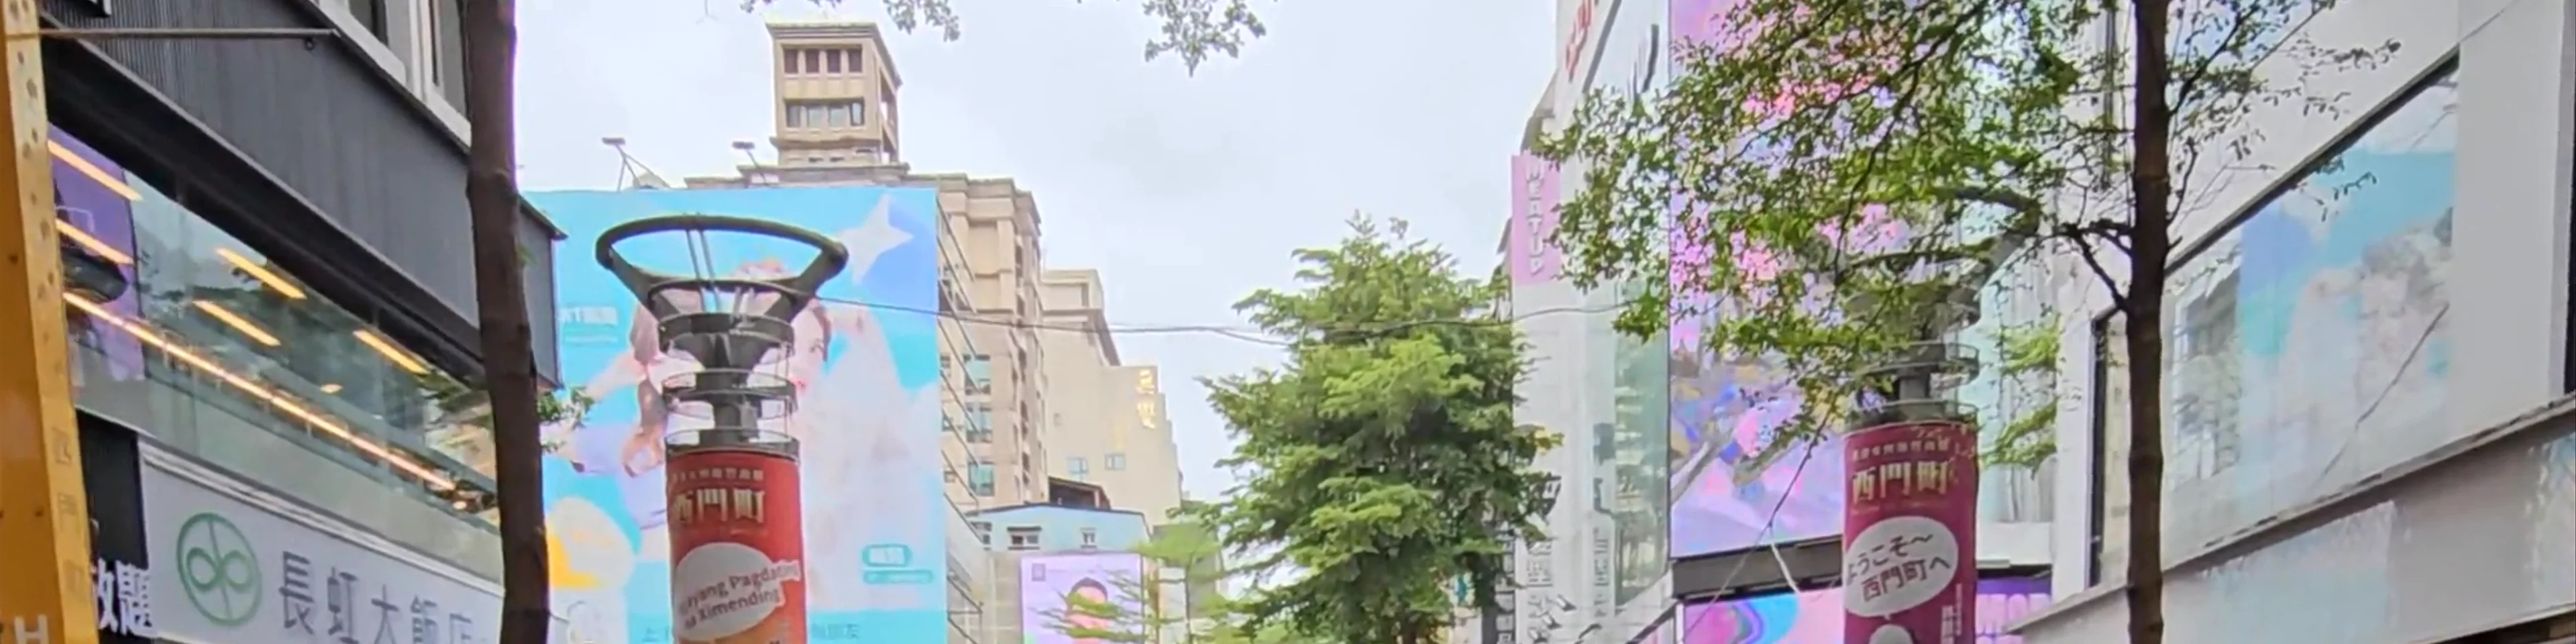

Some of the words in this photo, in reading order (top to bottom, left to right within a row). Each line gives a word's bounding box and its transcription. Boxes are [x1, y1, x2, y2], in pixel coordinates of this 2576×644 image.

[1853, 460, 1949, 504] 西門町
[673, 488, 765, 524] 西門町
[1862, 556, 1951, 602] 西門町へ
